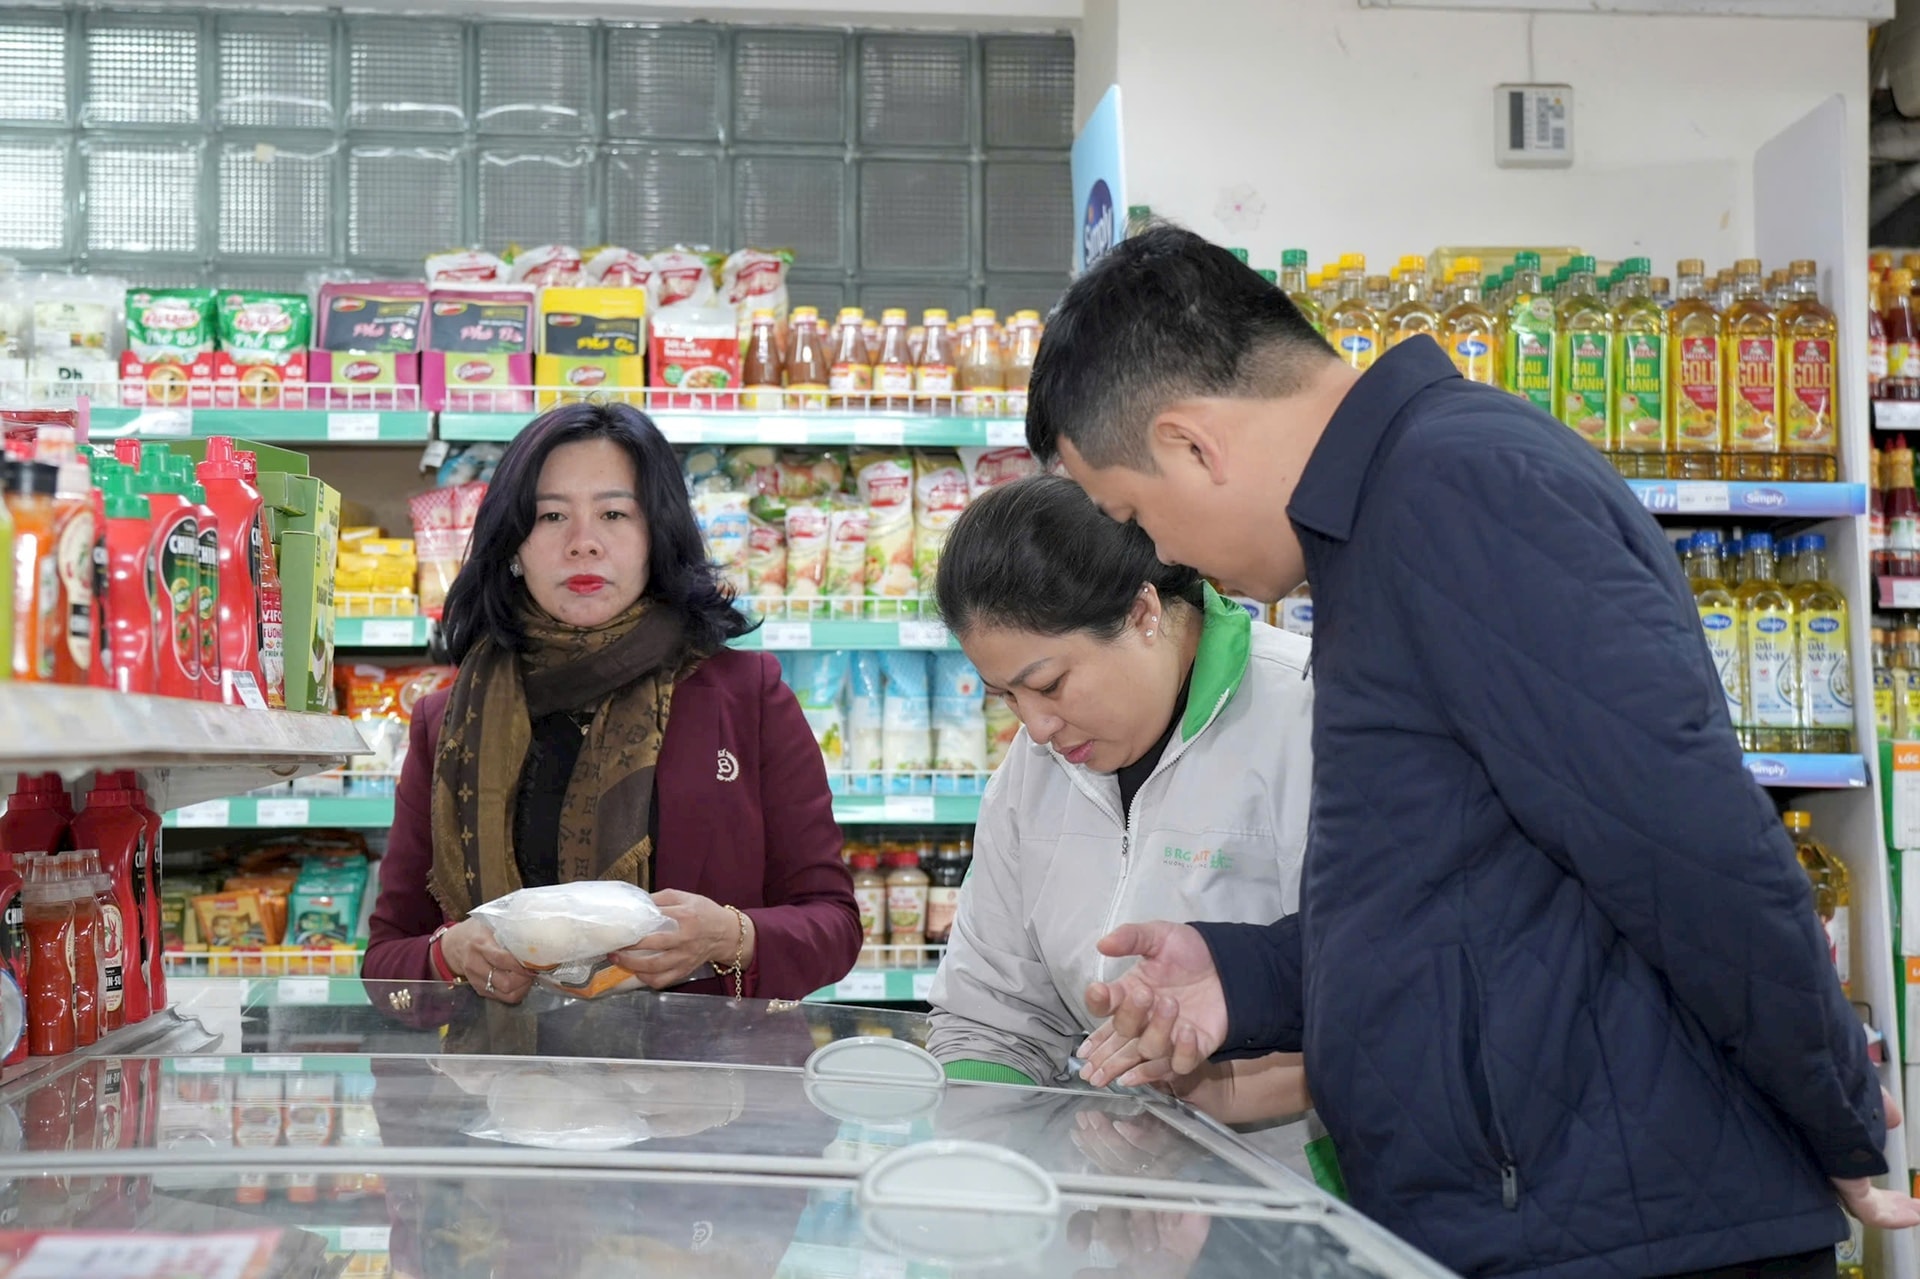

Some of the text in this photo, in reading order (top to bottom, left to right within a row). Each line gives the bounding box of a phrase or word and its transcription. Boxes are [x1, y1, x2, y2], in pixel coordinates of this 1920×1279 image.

[58, 367, 83, 380] Dh
[1793, 363, 1831, 388] GOLD
[1746, 488, 1784, 507] Simply
